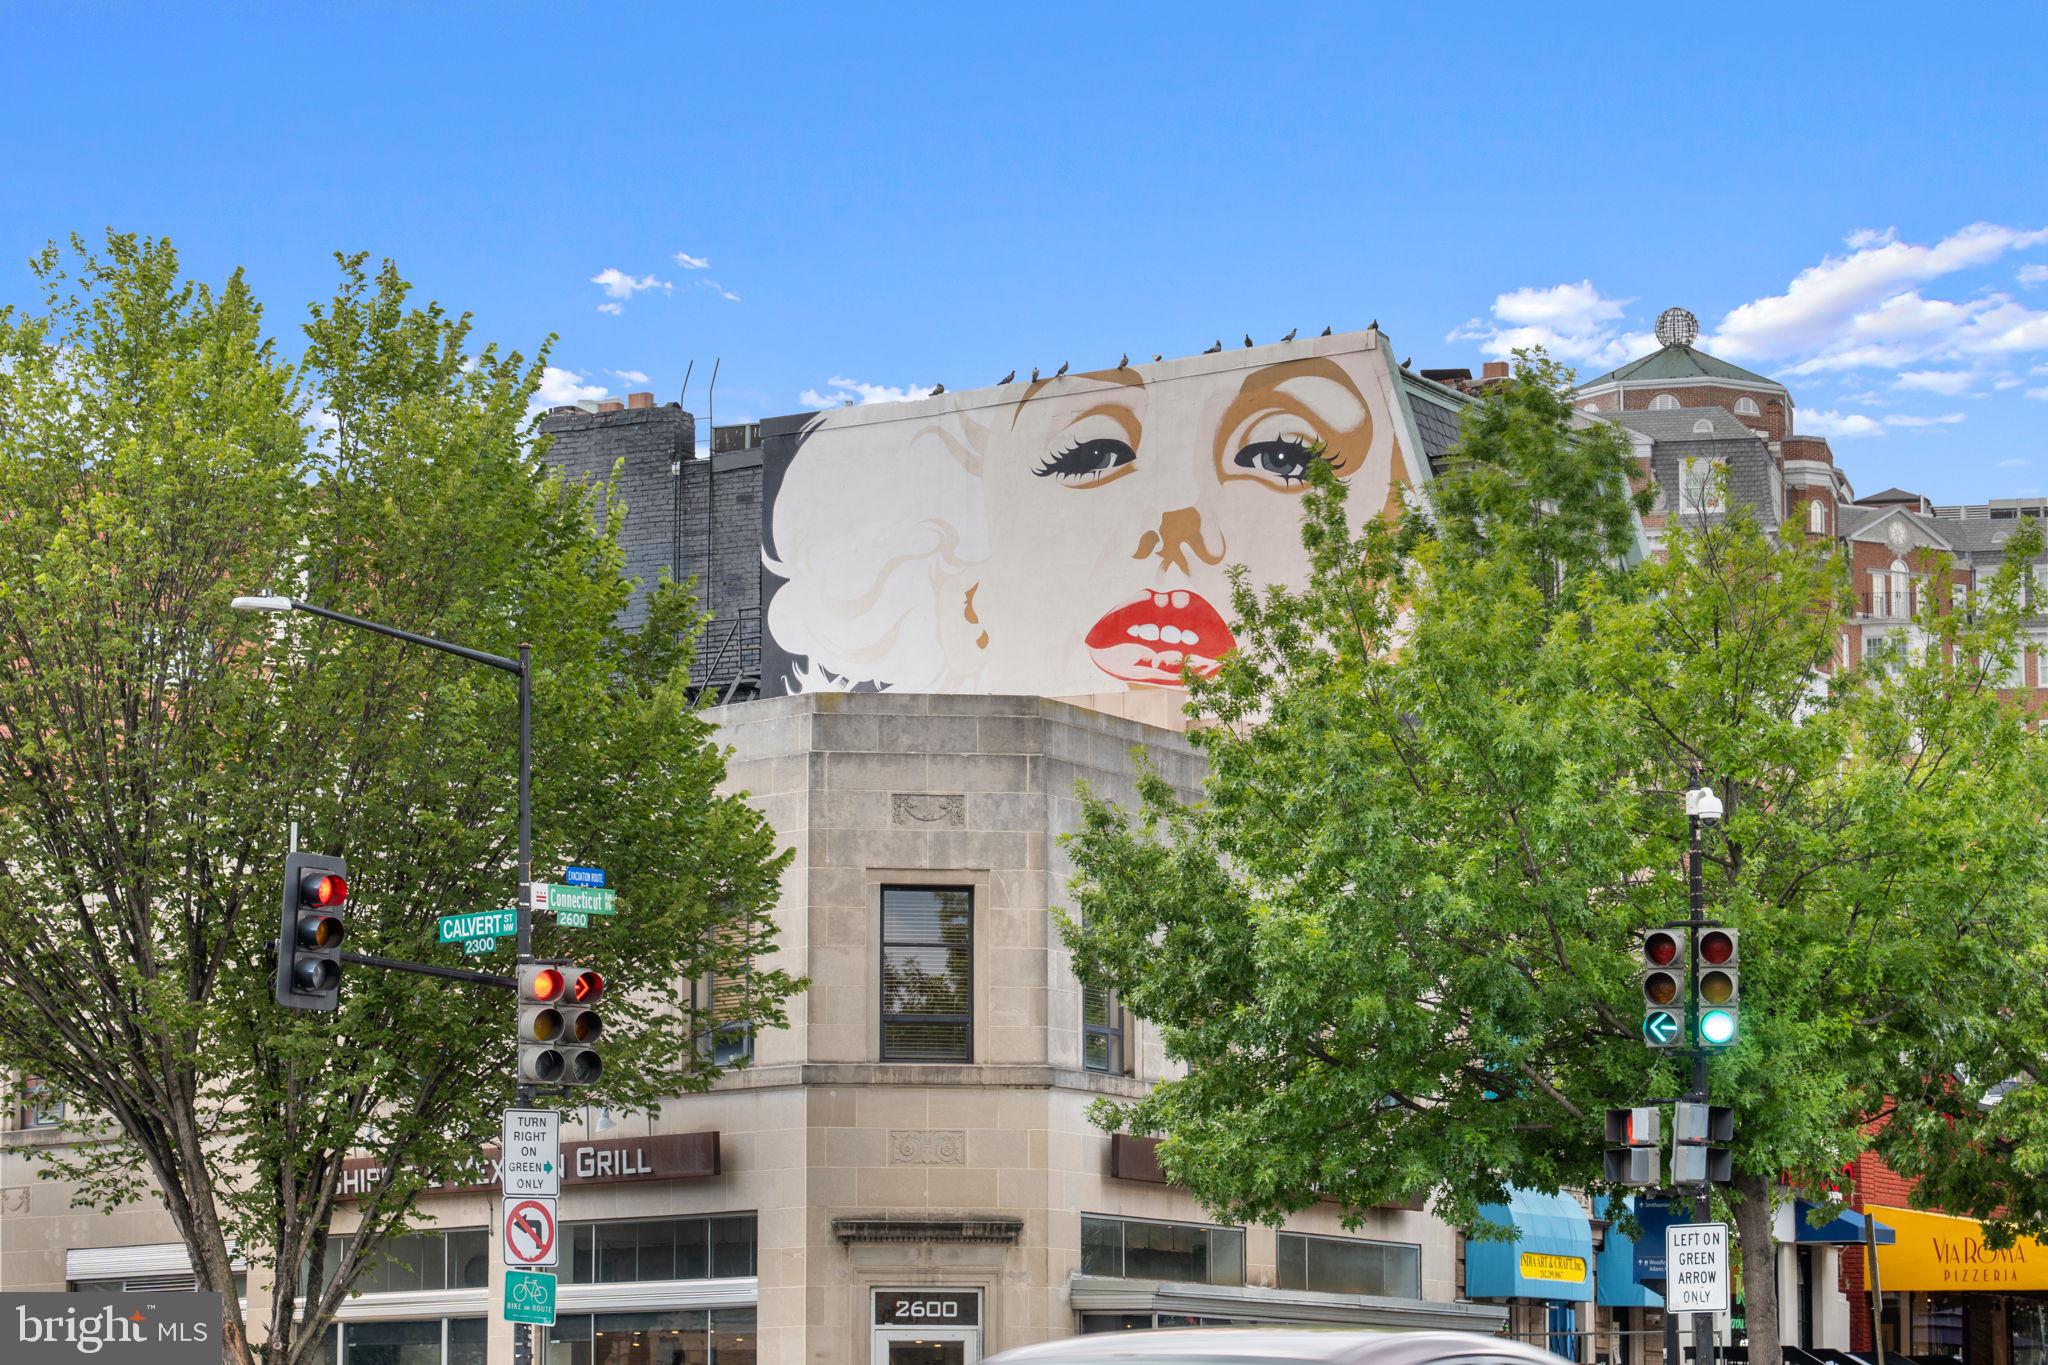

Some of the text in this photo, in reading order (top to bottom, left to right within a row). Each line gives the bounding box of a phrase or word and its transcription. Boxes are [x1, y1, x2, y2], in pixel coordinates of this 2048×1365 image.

[591, 873, 603, 883] ROUTE
[551, 889, 602, 911] Connecticut
[443, 914, 513, 939] CALVERT ST
[560, 914, 587, 927] 2600
[503, 923, 514, 932] NW
[465, 938, 494, 954] 2300
[517, 1117, 547, 1127] TURN
[514, 1131, 547, 1142] RIGHT
[521, 1146, 537, 1156] ON
[508, 1162, 542, 1172] GREEN
[577, 1147, 652, 1177] GRILL
[517, 1178, 544, 1189] ONLY
[1674, 1233, 1720, 1247] LEFT ON
[1933, 1237, 2025, 1264] VIA ROMA
[1549, 1256, 1554, 1268] &
[1679, 1252, 1715, 1265] GREEN
[1678, 1271, 1717, 1284] ARROW
[1944, 1269, 2017, 1282] PIZZERIA
[1683, 1290, 1711, 1304] ONLY
[507, 1302, 552, 1313] BIKE ROUTE
[895, 1301, 957, 1317] 2600
